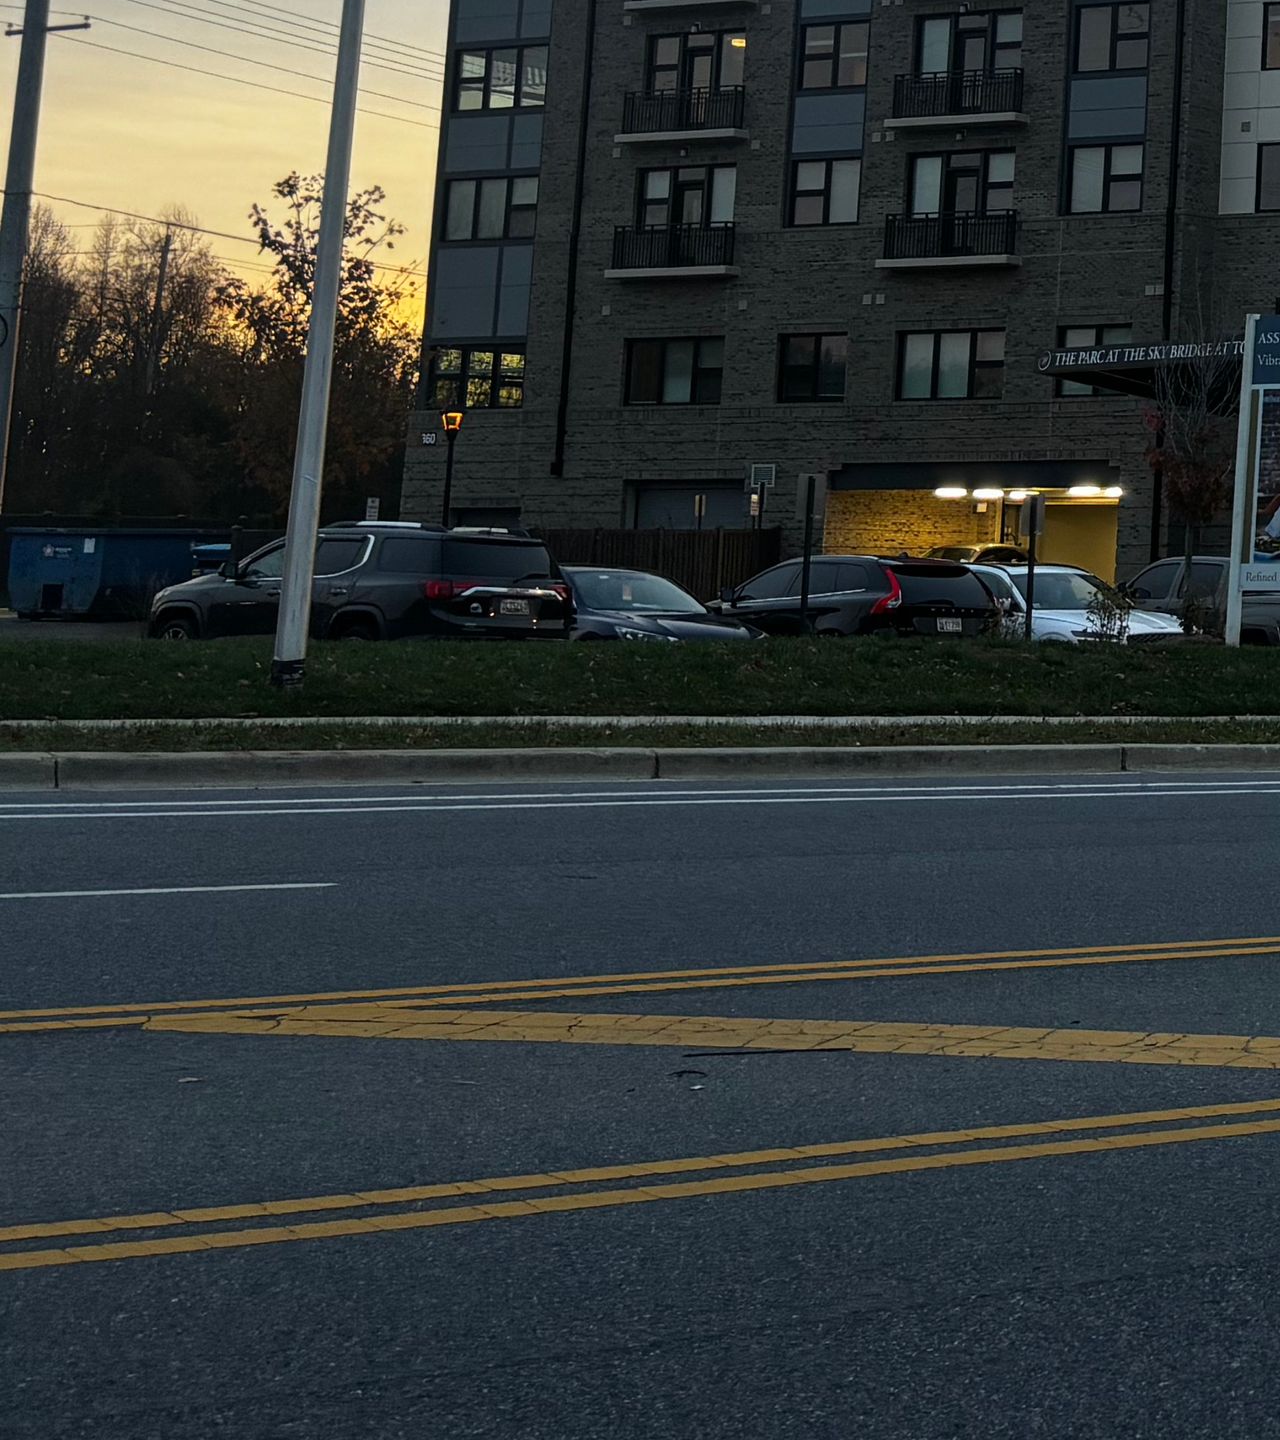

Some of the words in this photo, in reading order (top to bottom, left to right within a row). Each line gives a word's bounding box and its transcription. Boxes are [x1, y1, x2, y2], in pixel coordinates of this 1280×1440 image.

[1056, 352, 1078, 366] THE
[1078, 350, 1105, 364] PARC
[1105, 348, 1121, 363] AT
[1123, 347, 1146, 361] THE
[1147, 345, 1169, 360] SKY
[1246, 571, 1277, 582] Refined
